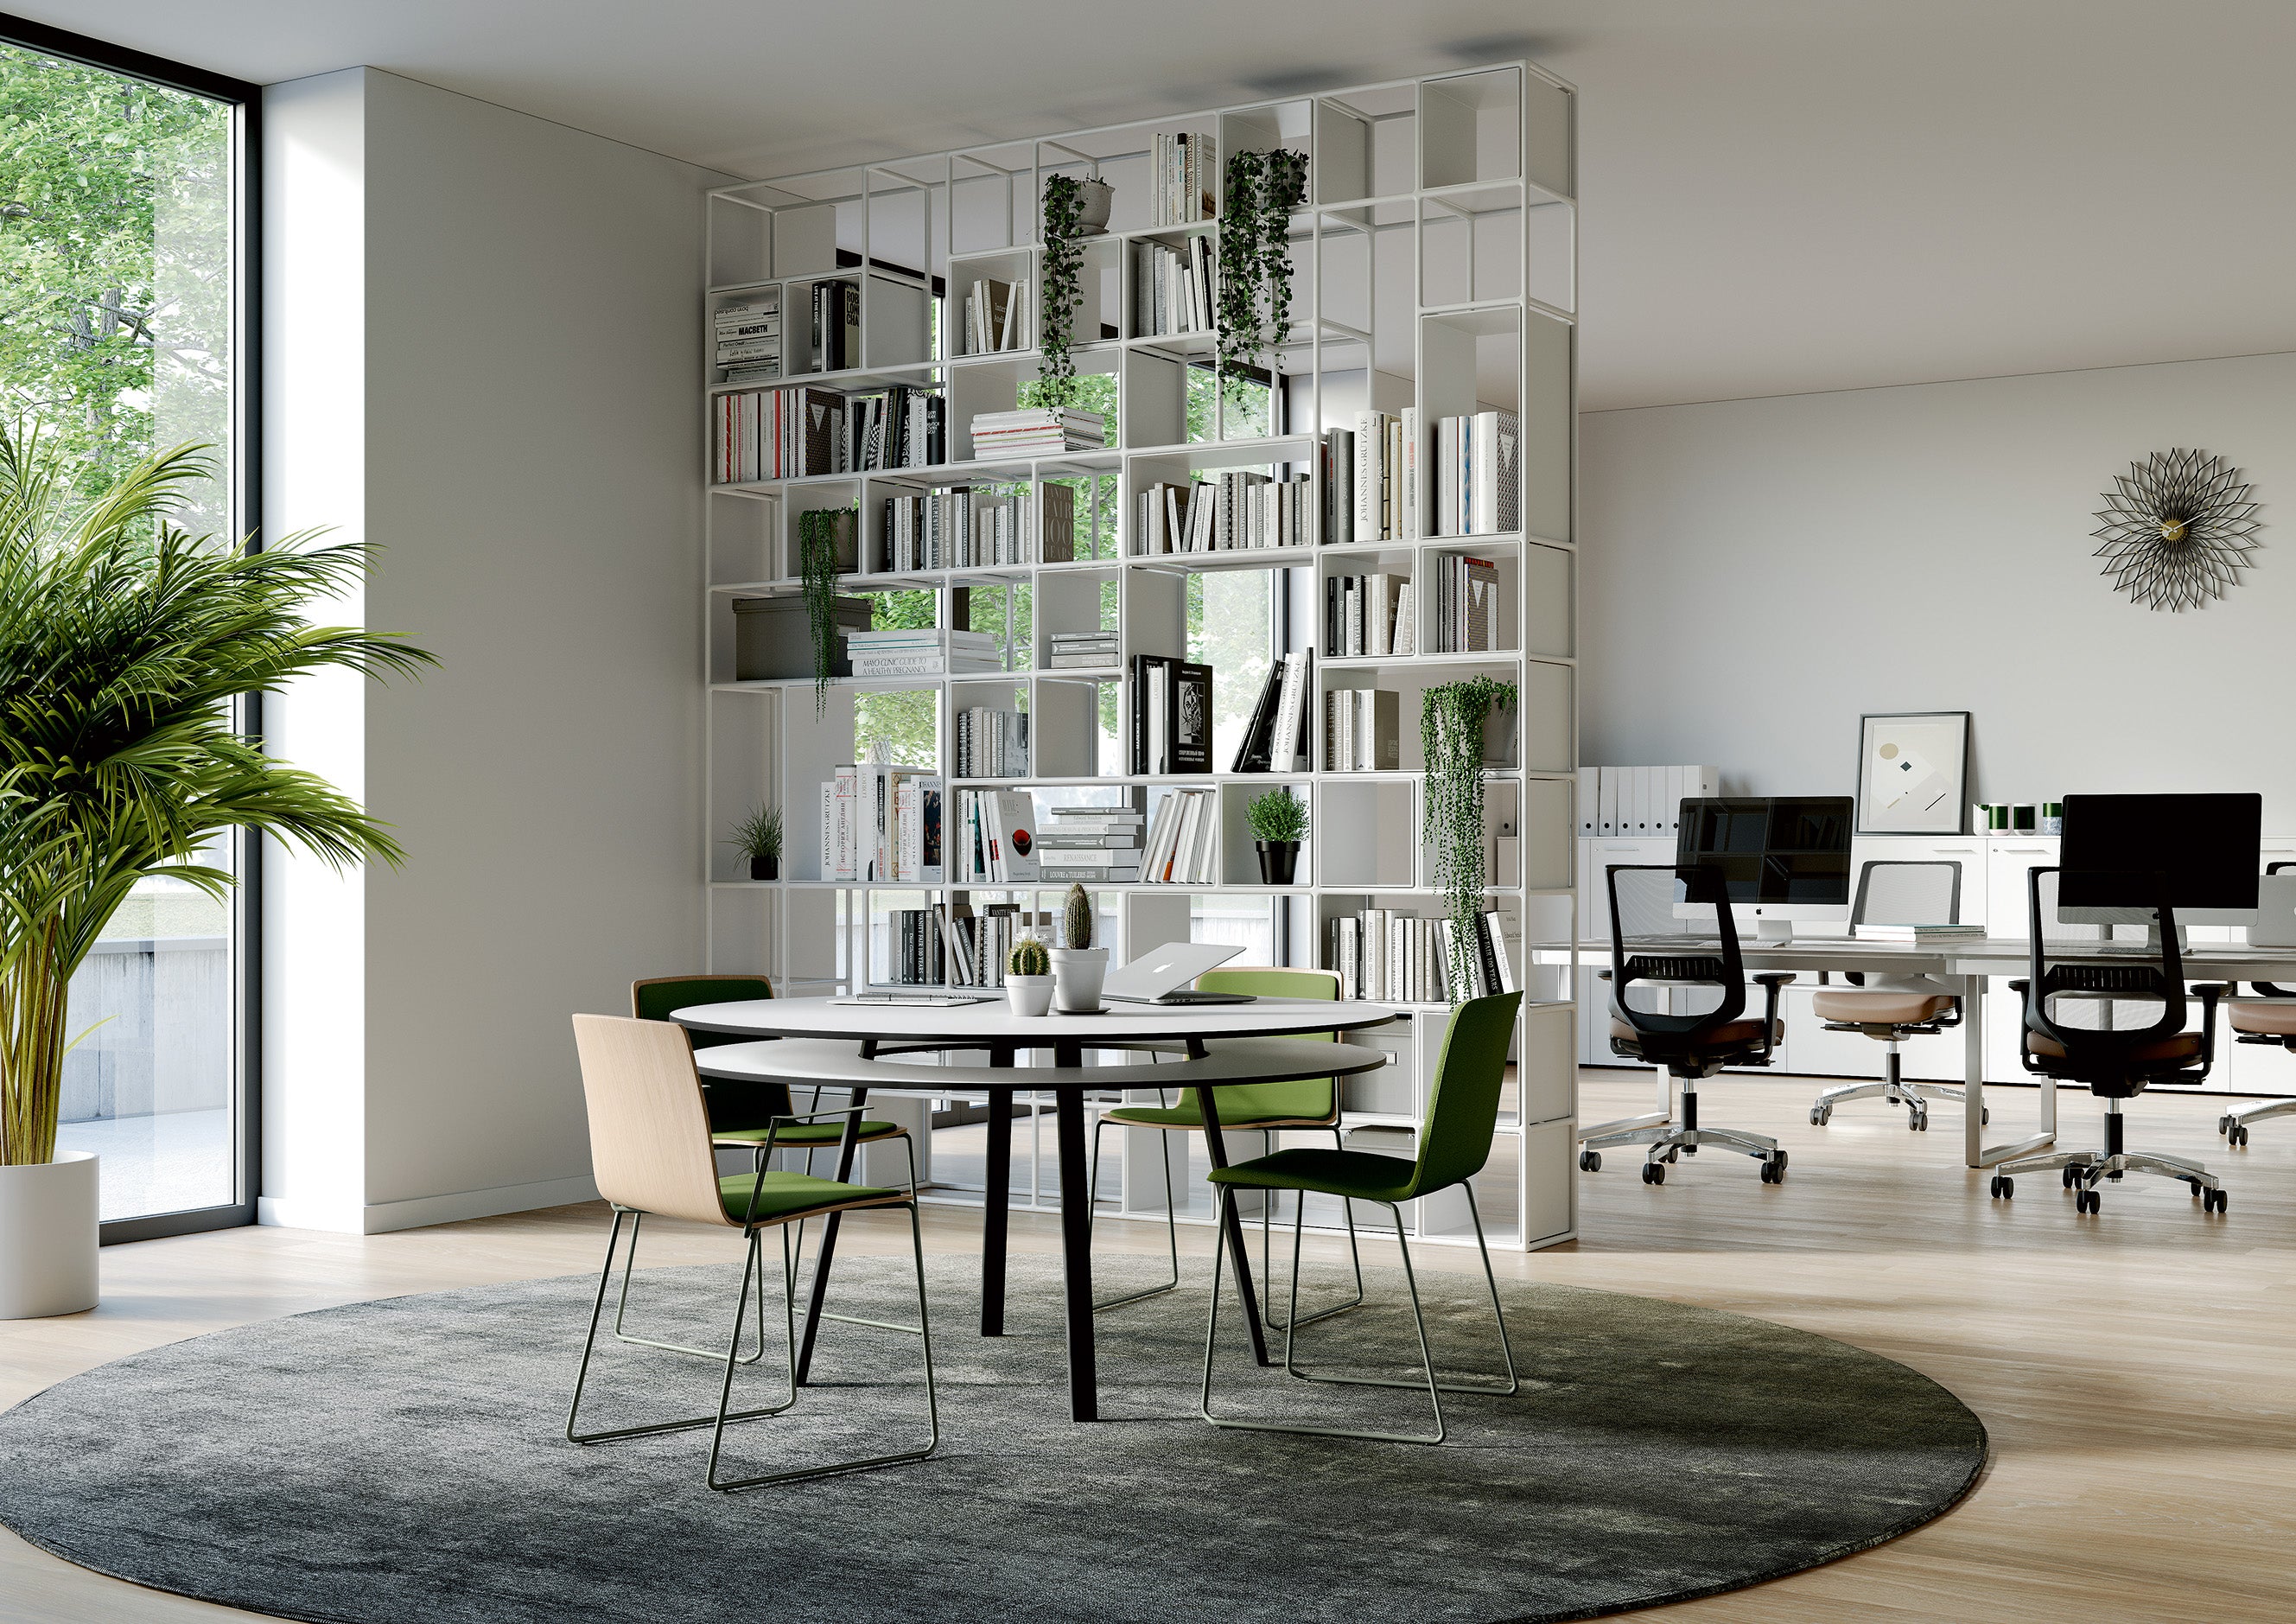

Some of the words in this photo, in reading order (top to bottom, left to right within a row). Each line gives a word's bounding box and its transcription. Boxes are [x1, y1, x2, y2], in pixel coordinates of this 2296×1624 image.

[738, 324, 768, 336] MACBETH
[1045, 518, 1072, 546] 100
[1328, 733, 1334, 741] OF
[1480, 914, 1488, 939] VANITY
[1489, 968, 1498, 990] YEARS
